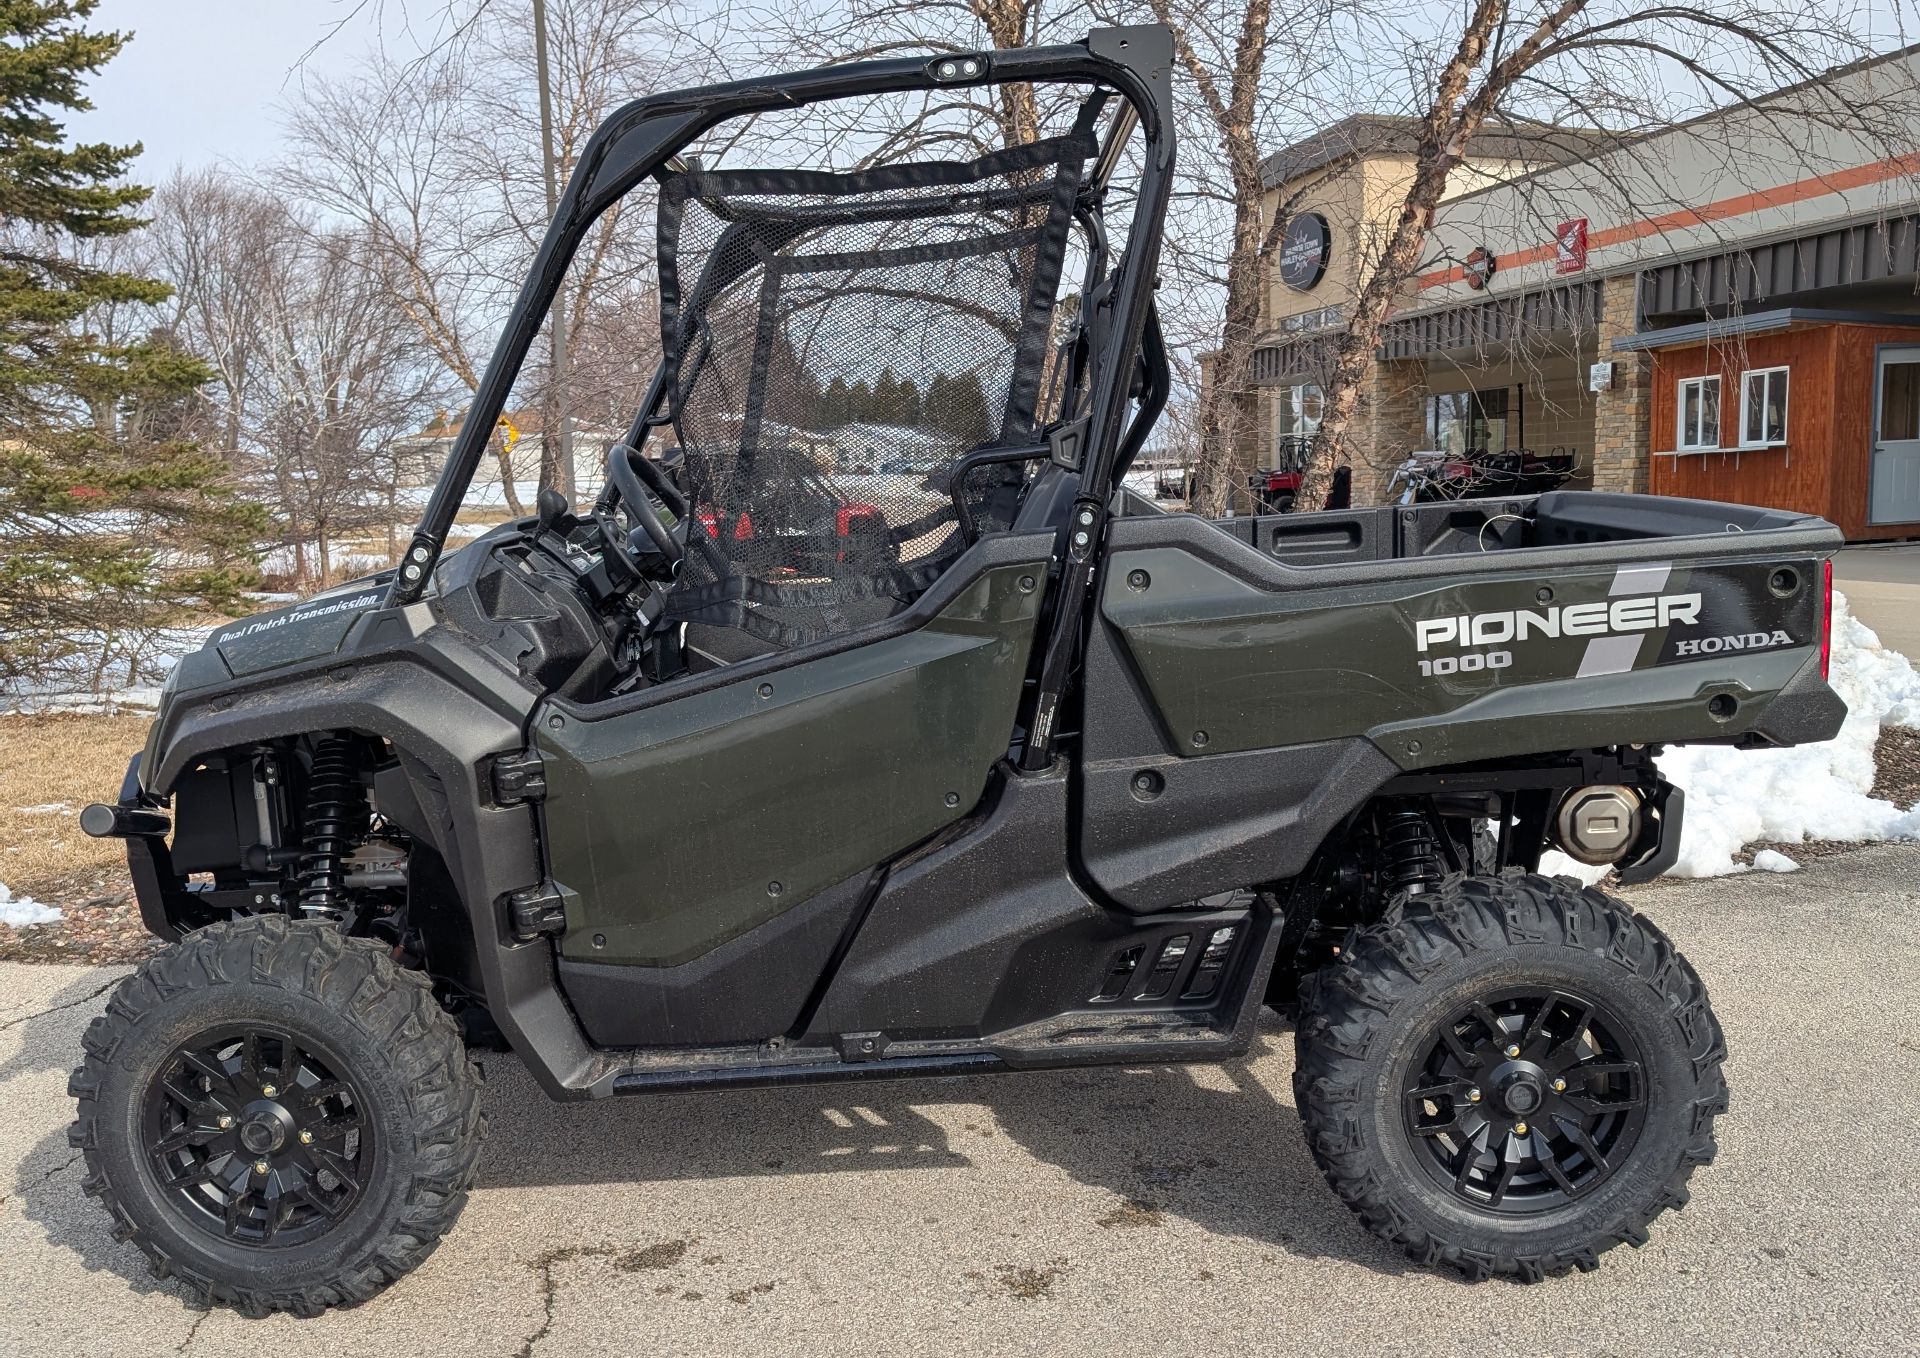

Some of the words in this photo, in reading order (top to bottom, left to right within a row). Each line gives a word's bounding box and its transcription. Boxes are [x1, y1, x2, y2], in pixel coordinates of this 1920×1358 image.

[218, 627, 246, 643] Dual
[247, 615, 286, 635] Clutch
[288, 594, 379, 623] Transmission
[1416, 593, 1701, 651] PIONEER
[1675, 630, 1795, 656] HONDA
[1417, 651, 1513, 677] 1000
